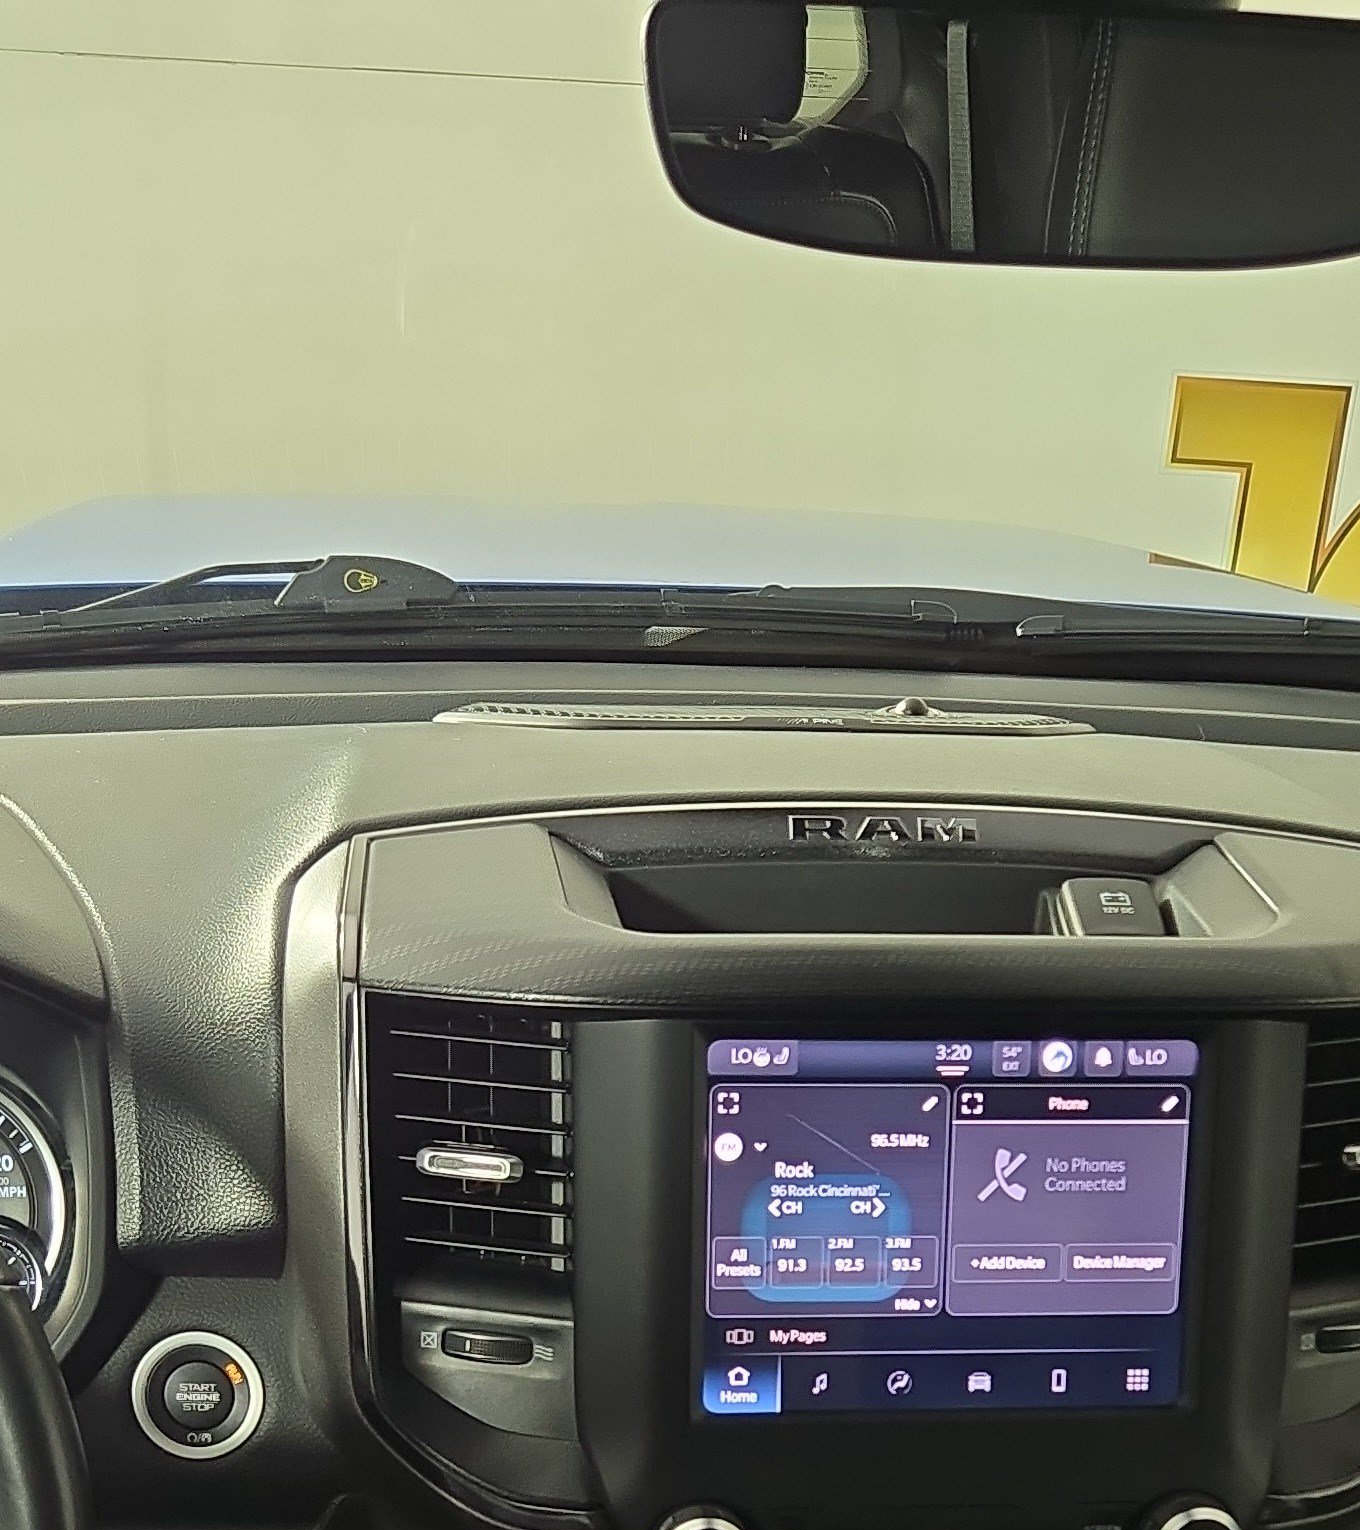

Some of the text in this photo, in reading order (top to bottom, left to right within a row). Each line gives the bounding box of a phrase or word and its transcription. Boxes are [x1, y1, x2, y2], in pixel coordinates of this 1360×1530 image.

[787, 813, 979, 844] RAM
[730, 1047, 752, 1064] LO
[934, 1044, 973, 1061] 3:20
[1145, 1049, 1168, 1065] LO
[1048, 1096, 1089, 1111] Phone
[774, 1161, 815, 1179] Rock
[1045, 1157, 1126, 1173] No Phones
[770, 1185, 788, 1197] 96
[789, 1184, 817, 1197] Rock
[1044, 1176, 1127, 1192] Connected
[781, 1200, 803, 1215] CH
[850, 1200, 871, 1215] CH
[730, 1248, 748, 1262] All
[716, 1263, 762, 1277] Presets
[777, 1258, 807, 1272] 91.3
[835, 1258, 865, 1272] 92.5
[891, 1257, 922, 1271] 93.5
[1006, 1256, 1046, 1270] Device
[1073, 1255, 1167, 1272] Device Manager
[894, 1298, 921, 1311] Hide
[769, 1329, 828, 1345] My Pages
[179, 1383, 218, 1392] START
[175, 1393, 221, 1402] ENGINE
[719, 1390, 758, 1404] Home
[182, 1402, 215, 1412] STOP
